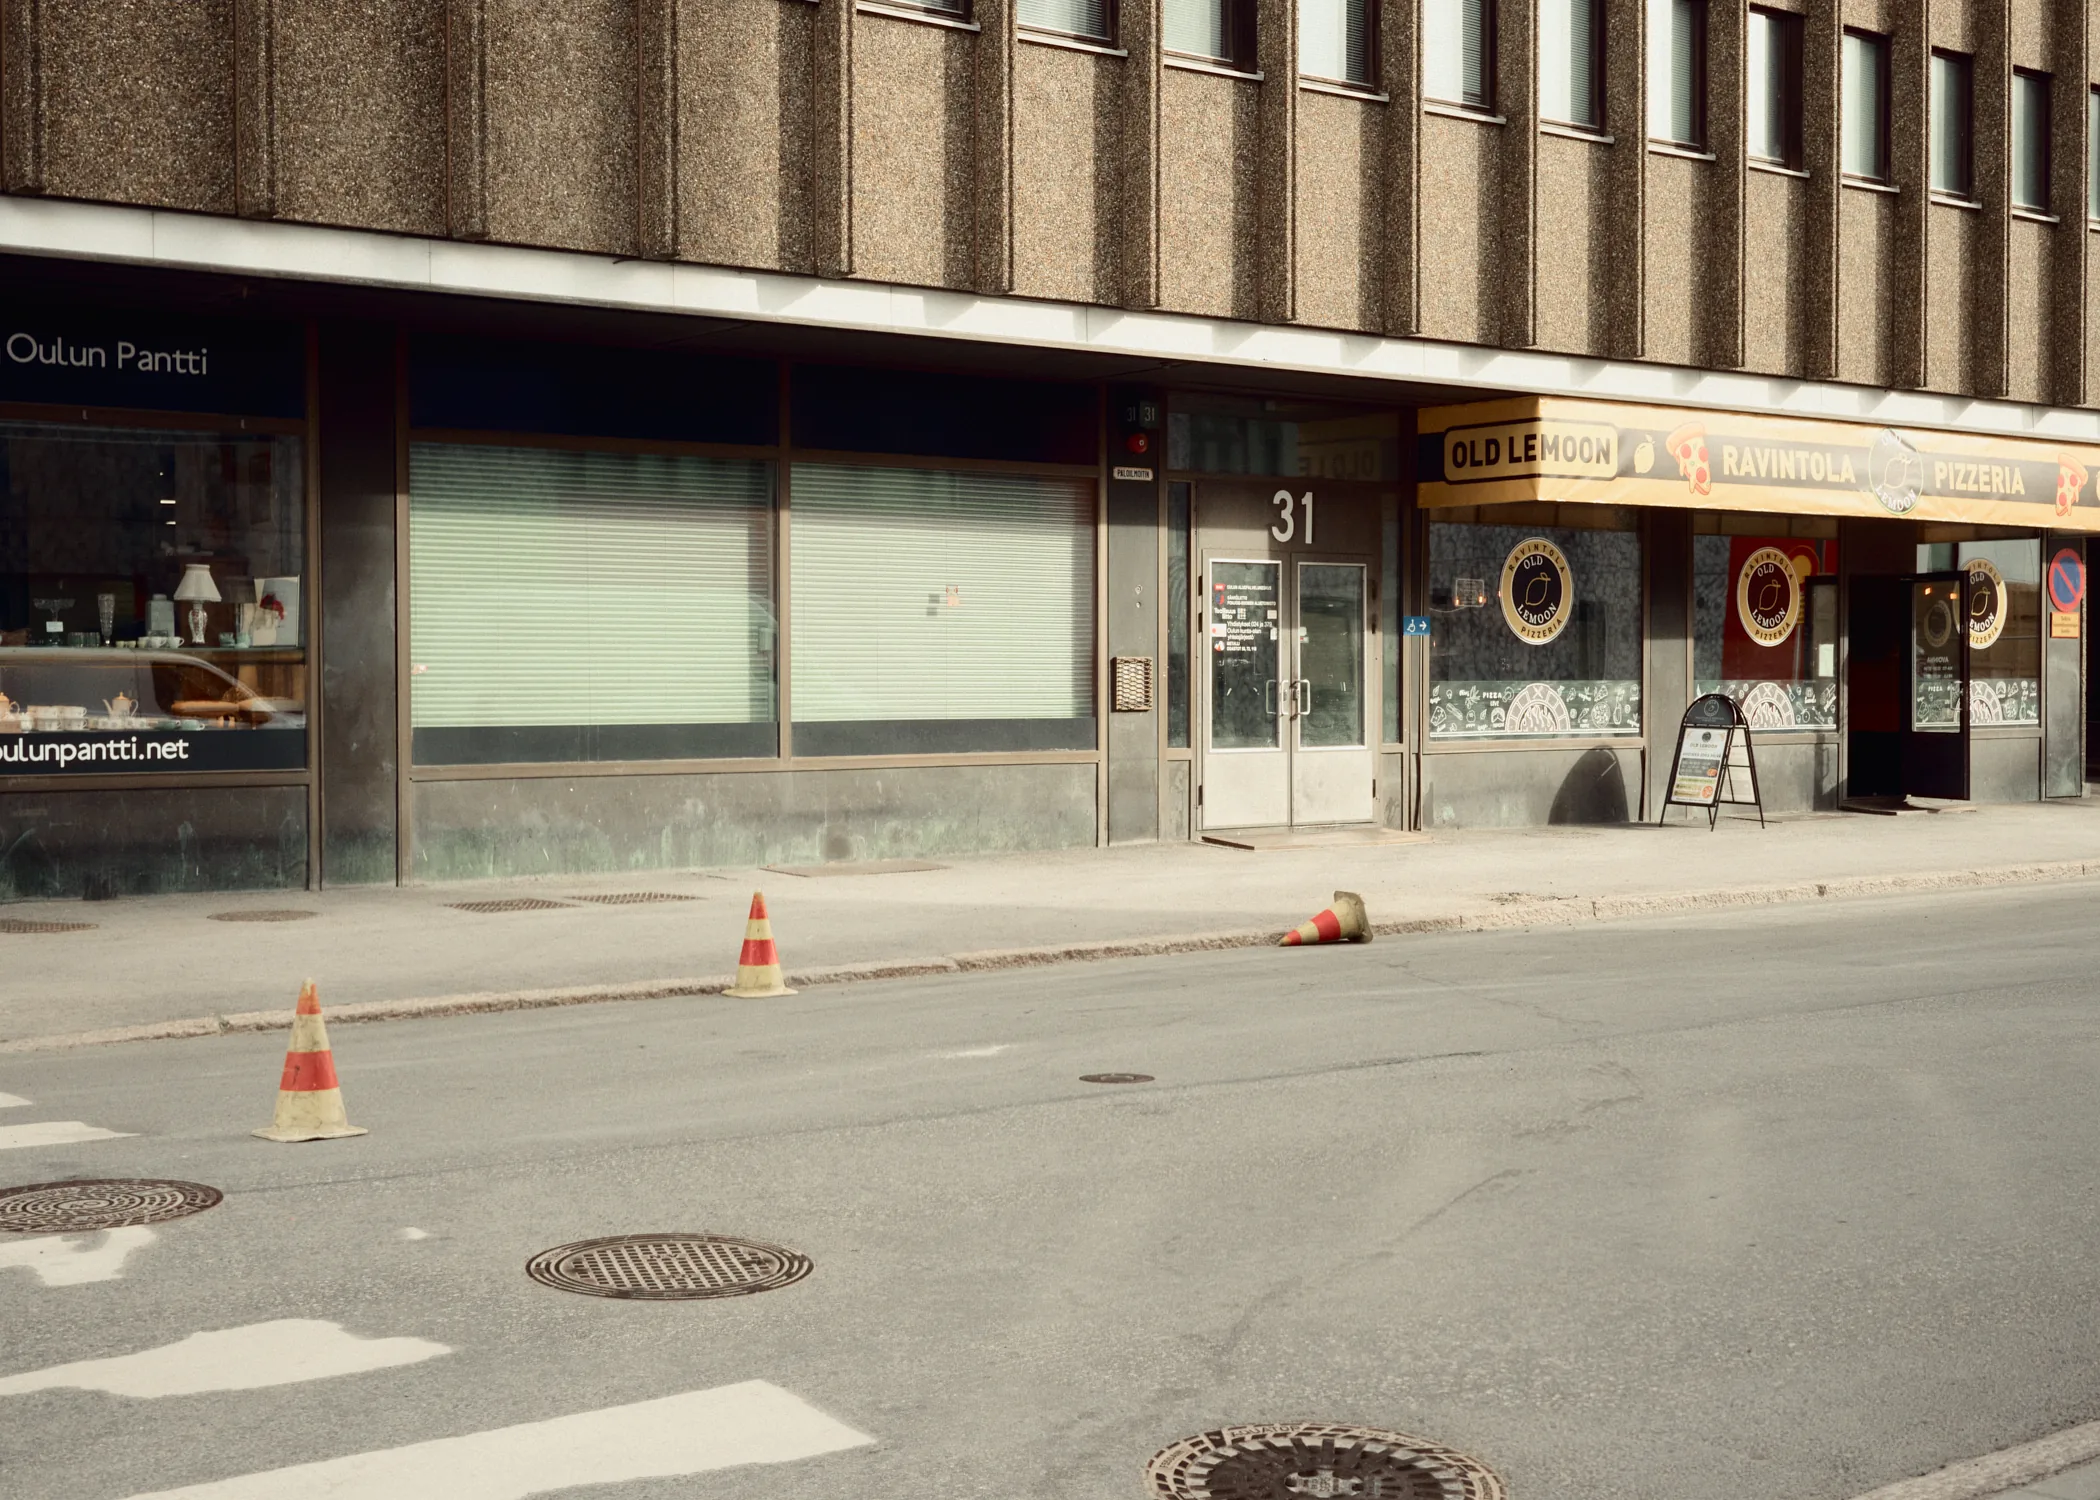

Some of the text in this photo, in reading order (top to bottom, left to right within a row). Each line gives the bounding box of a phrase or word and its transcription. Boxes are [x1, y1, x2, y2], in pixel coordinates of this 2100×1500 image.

[6, 333, 208, 375] Oulun Pantti
[1144, 407, 1155, 421] 31
[1452, 433, 1611, 468] OLD LEMOON
[1722, 444, 1857, 484] RAVINTOLA
[1934, 460, 2026, 496] PIZZERIA
[1874, 483, 1918, 511] LEMOON
[1271, 489, 1313, 544] 31
[1508, 543, 1566, 573] RAVINTOLA
[1523, 555, 1543, 569] OLD
[1744, 552, 1794, 580] RAVINTOLA
[1757, 563, 1775, 577] OLD
[1970, 572, 1985, 584] OLD
[1517, 603, 1557, 624] LEMOON
[1752, 607, 1787, 628] LEMOON
[1970, 612, 1995, 632] EMOON
[1520, 618, 1562, 639] PIZZERIA
[1754, 622, 1791, 640] PIZZERIA
[1482, 691, 1502, 699] PIZZA
[0, 736, 189, 768] ulunpantti.net
